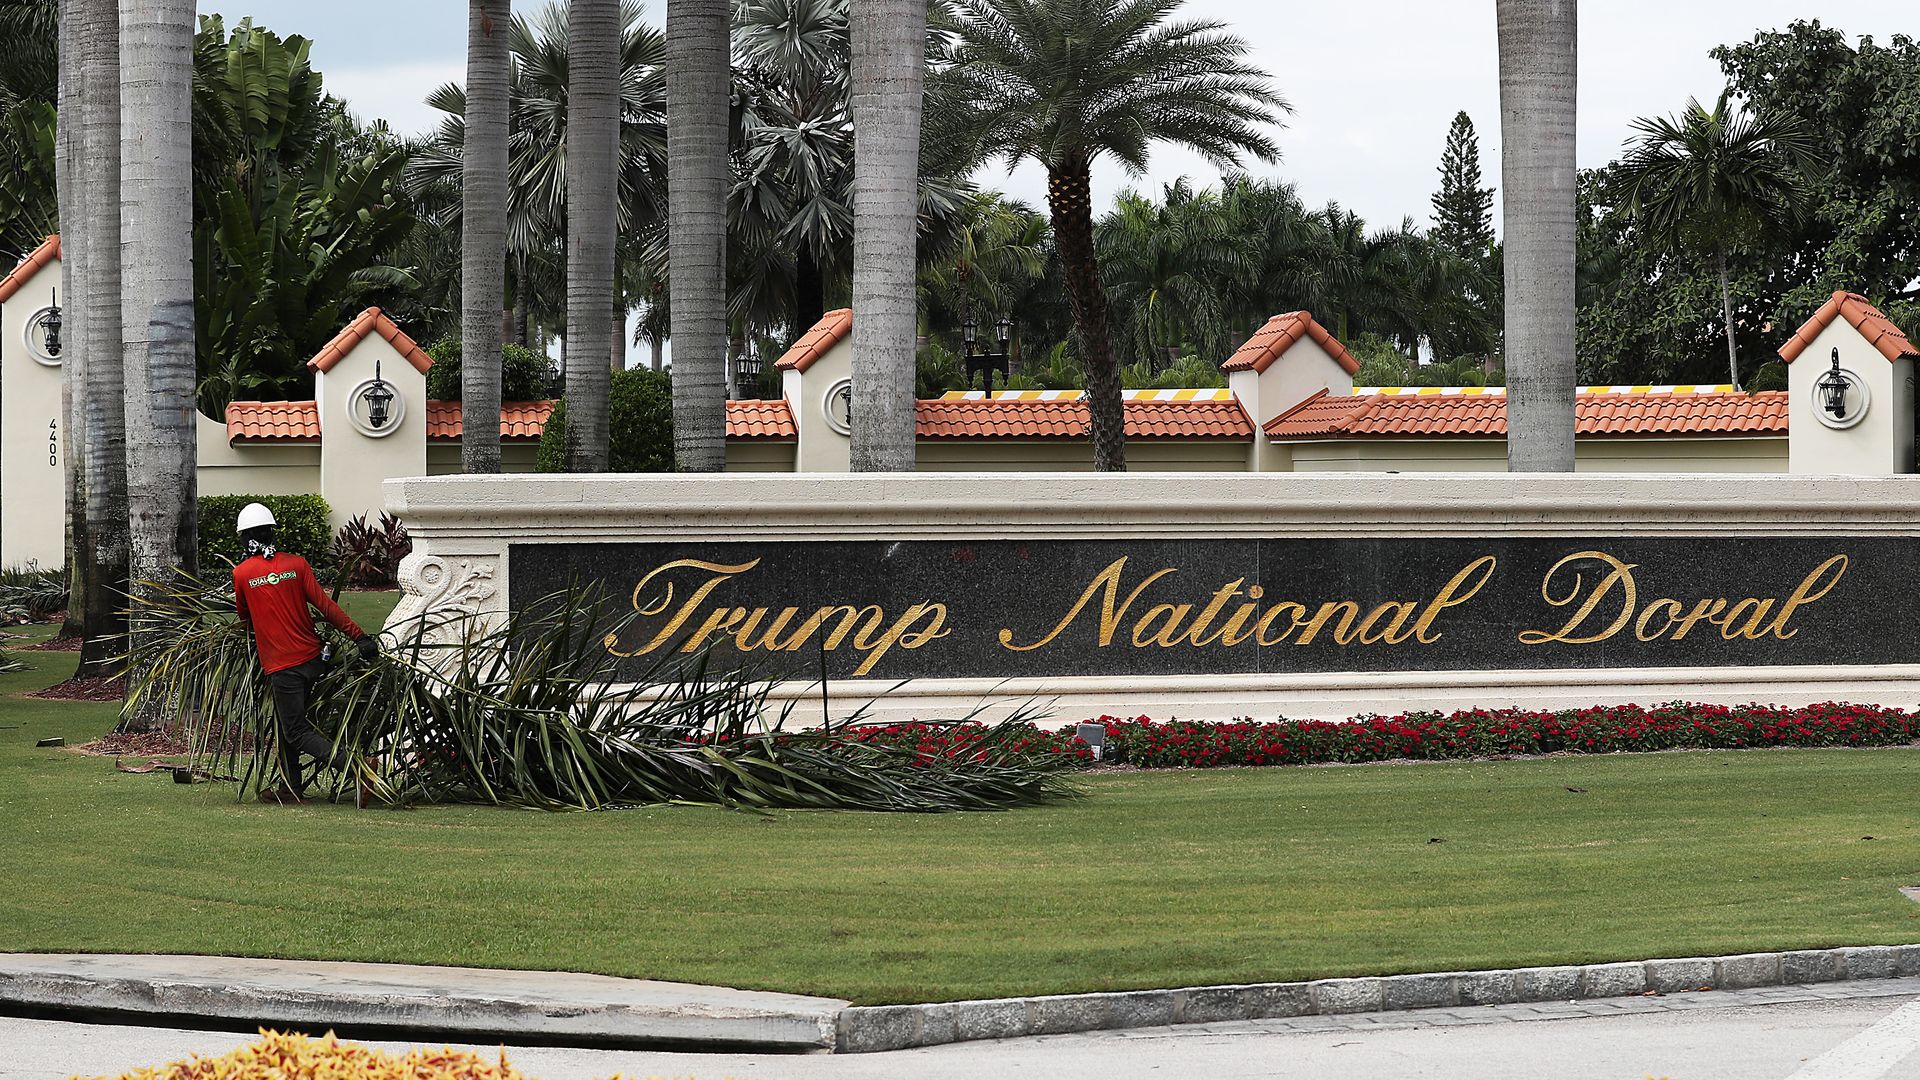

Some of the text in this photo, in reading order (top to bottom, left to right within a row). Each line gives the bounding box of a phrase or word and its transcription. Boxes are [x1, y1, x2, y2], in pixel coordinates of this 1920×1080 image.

[49, 418, 57, 467] 4400
[249, 577, 268, 587] TOTAL
[603, 550, 1848, 676] Trump National Doral
